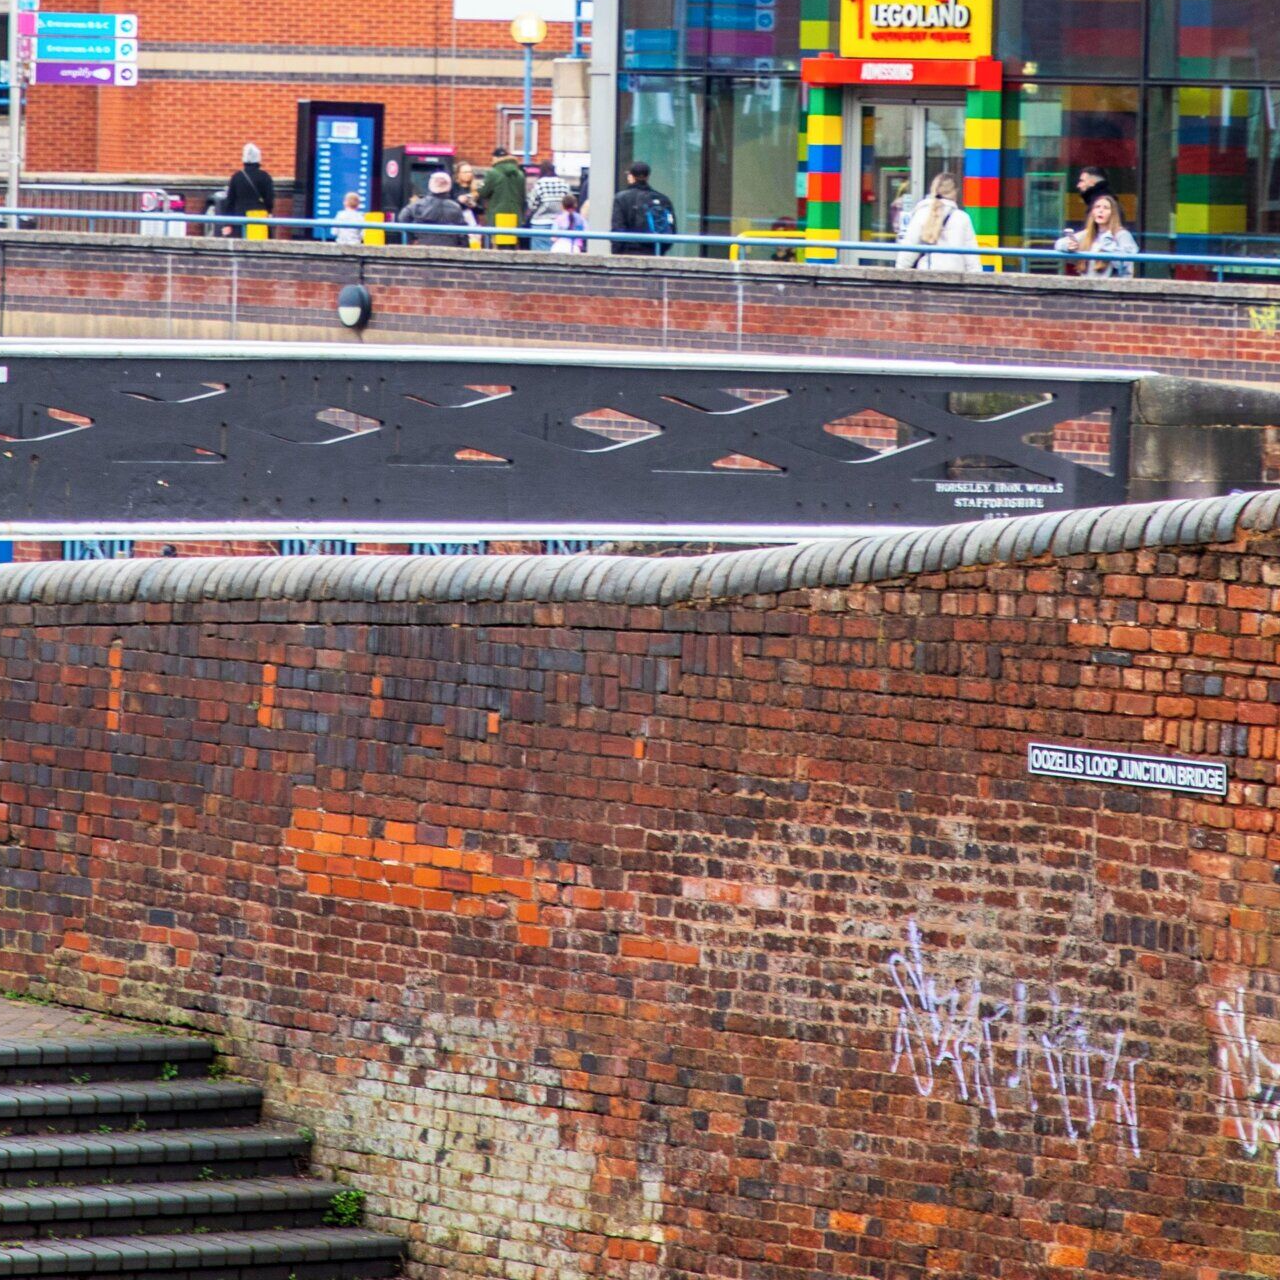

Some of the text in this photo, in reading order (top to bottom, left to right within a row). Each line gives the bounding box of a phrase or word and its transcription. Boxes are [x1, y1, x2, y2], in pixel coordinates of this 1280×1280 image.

[954, 497, 1045, 509] STAFFORDSHIRE
[1031, 749, 1224, 790] OOZELLS LOOP JUNCTION BRIDGE
